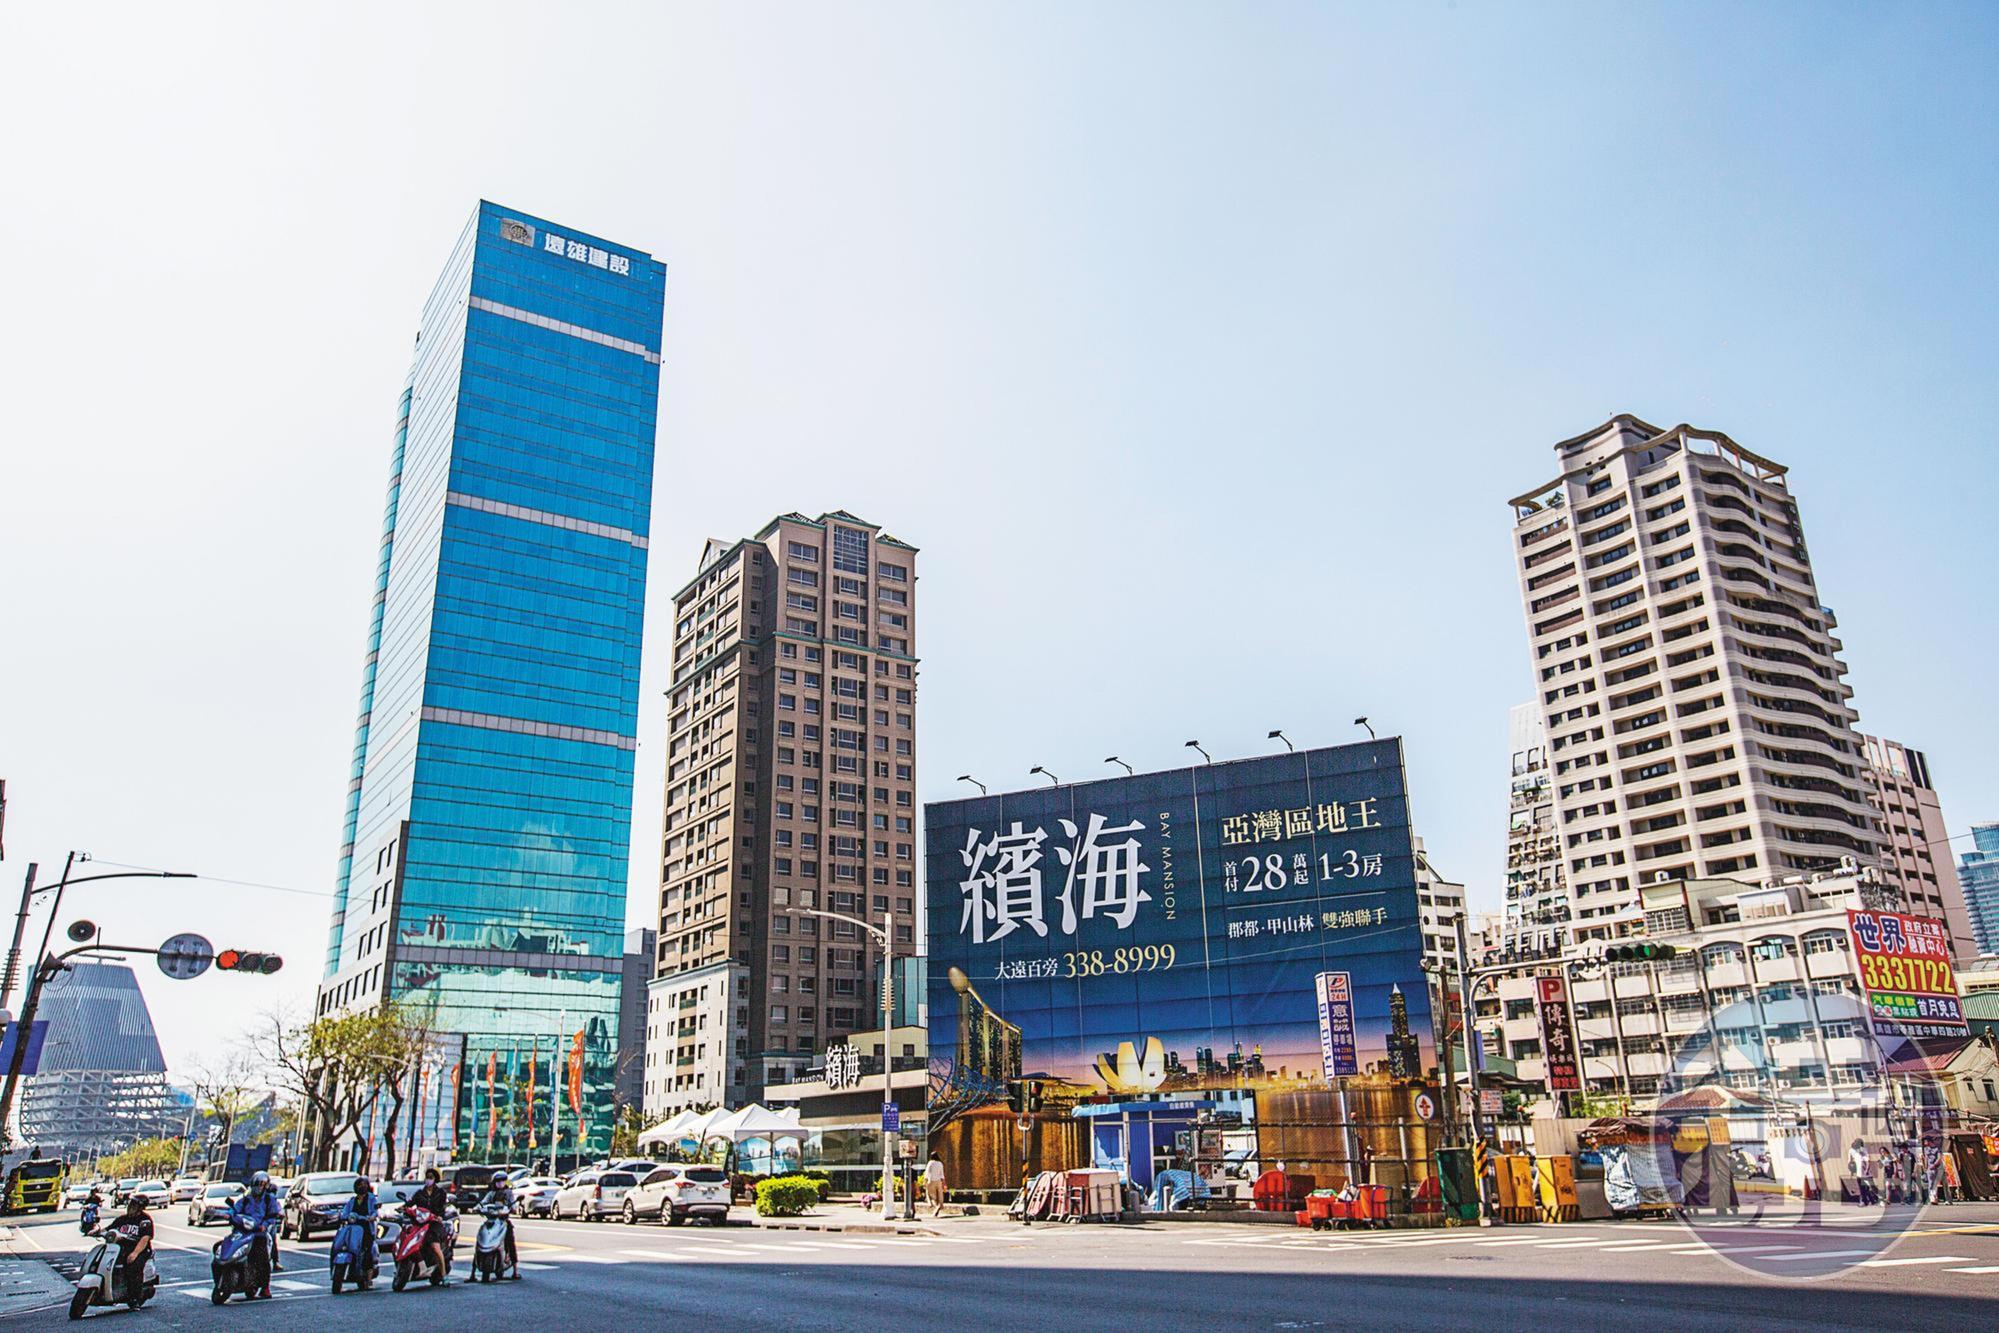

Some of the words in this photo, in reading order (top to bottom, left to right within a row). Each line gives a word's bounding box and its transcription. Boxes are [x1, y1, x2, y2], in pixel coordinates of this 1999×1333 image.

[544, 232, 630, 276] 遠雄建設
[1159, 812, 1171, 839] BAY
[1222, 797, 1382, 845] 亞灣區地王
[958, 812, 1152, 944] 繽海
[1161, 847, 1176, 920] MANSION
[1223, 861, 1240, 893] 首付
[1241, 853, 1287, 892] 28
[1292, 852, 1310, 886] 萬起
[1317, 849, 1384, 881] 1-3房
[1322, 907, 1388, 929] 雙強聯手
[1853, 913, 1907, 954] 世界
[994, 957, 1058, 981] 大遠百旁
[1063, 943, 1176, 979] 338-8999
[1861, 954, 1955, 994] 3337722
[1541, 980, 1560, 1000] P
[1917, 999, 1960, 1019] 首月免息
